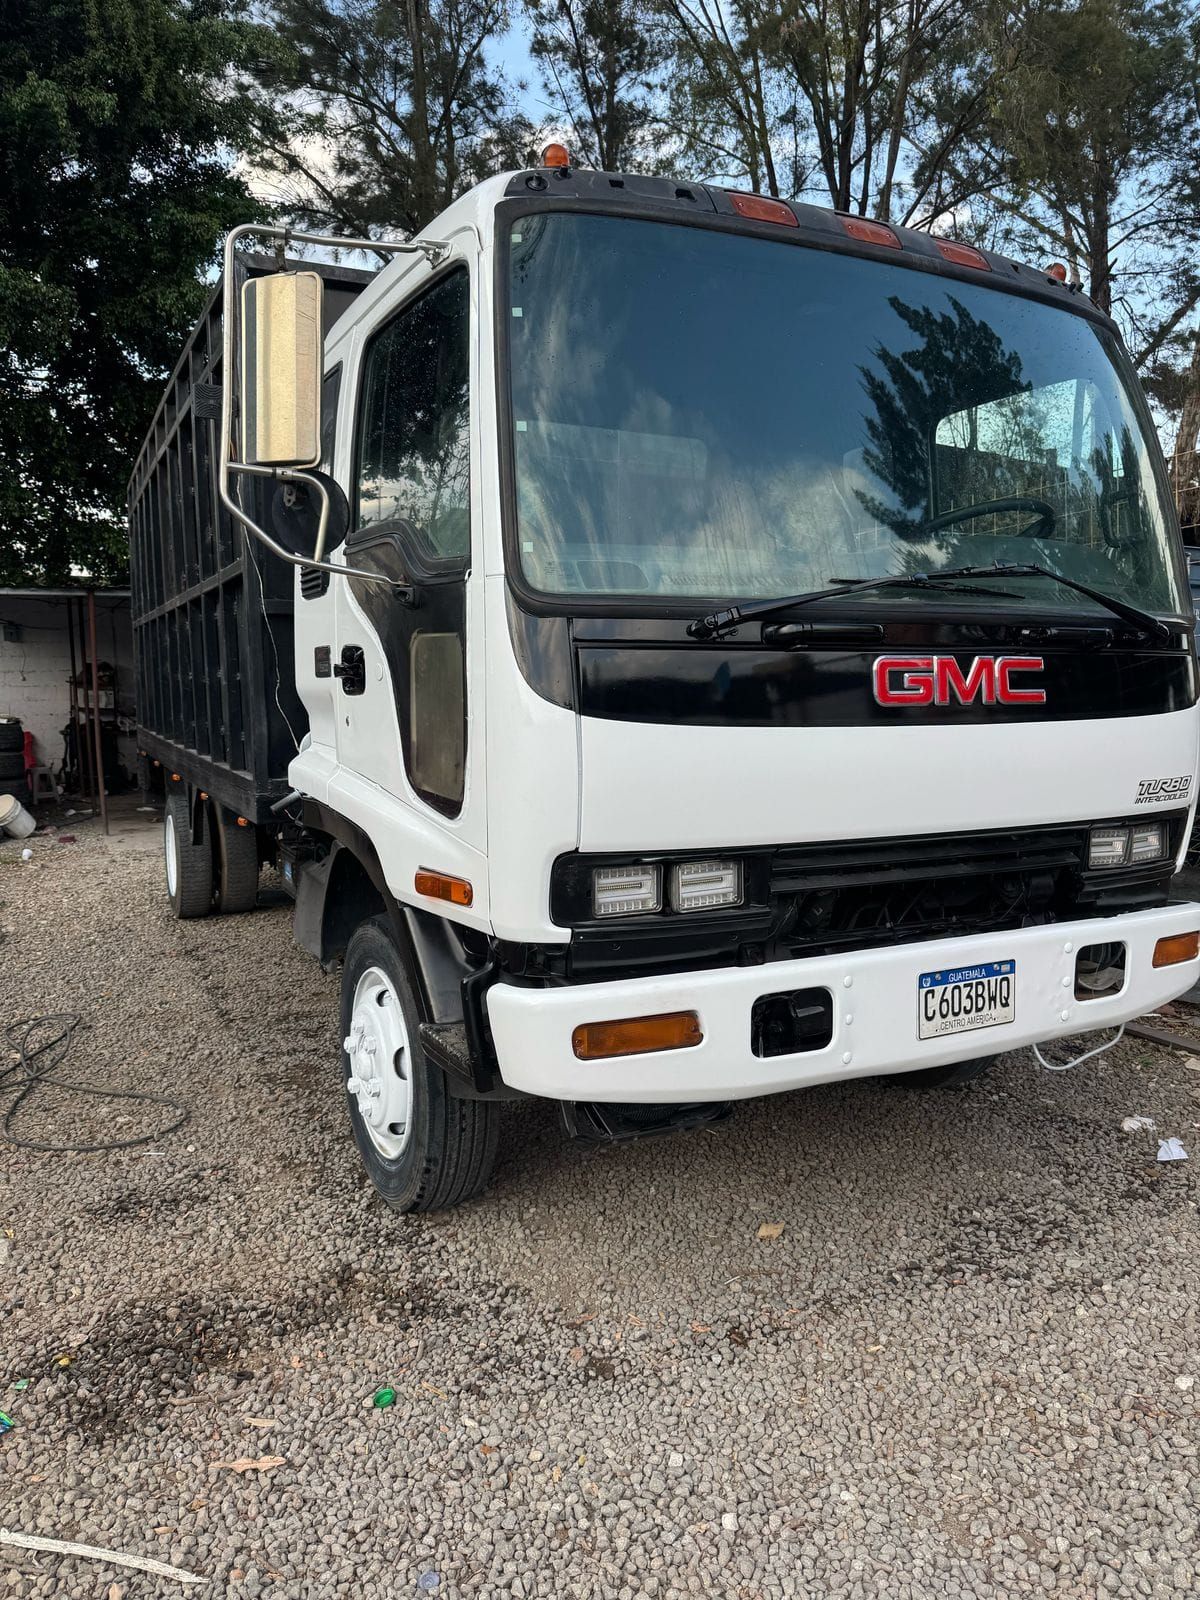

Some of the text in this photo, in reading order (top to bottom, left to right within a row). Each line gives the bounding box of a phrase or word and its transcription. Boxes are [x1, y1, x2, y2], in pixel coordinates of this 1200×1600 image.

[873, 655, 1046, 707] GMC
[1138, 775, 1192, 796] TURBO
[948, 967, 987, 983] GUATEMALA
[924, 976, 1010, 1022] C603BWQ
[940, 1018, 966, 1031] CENTRO
